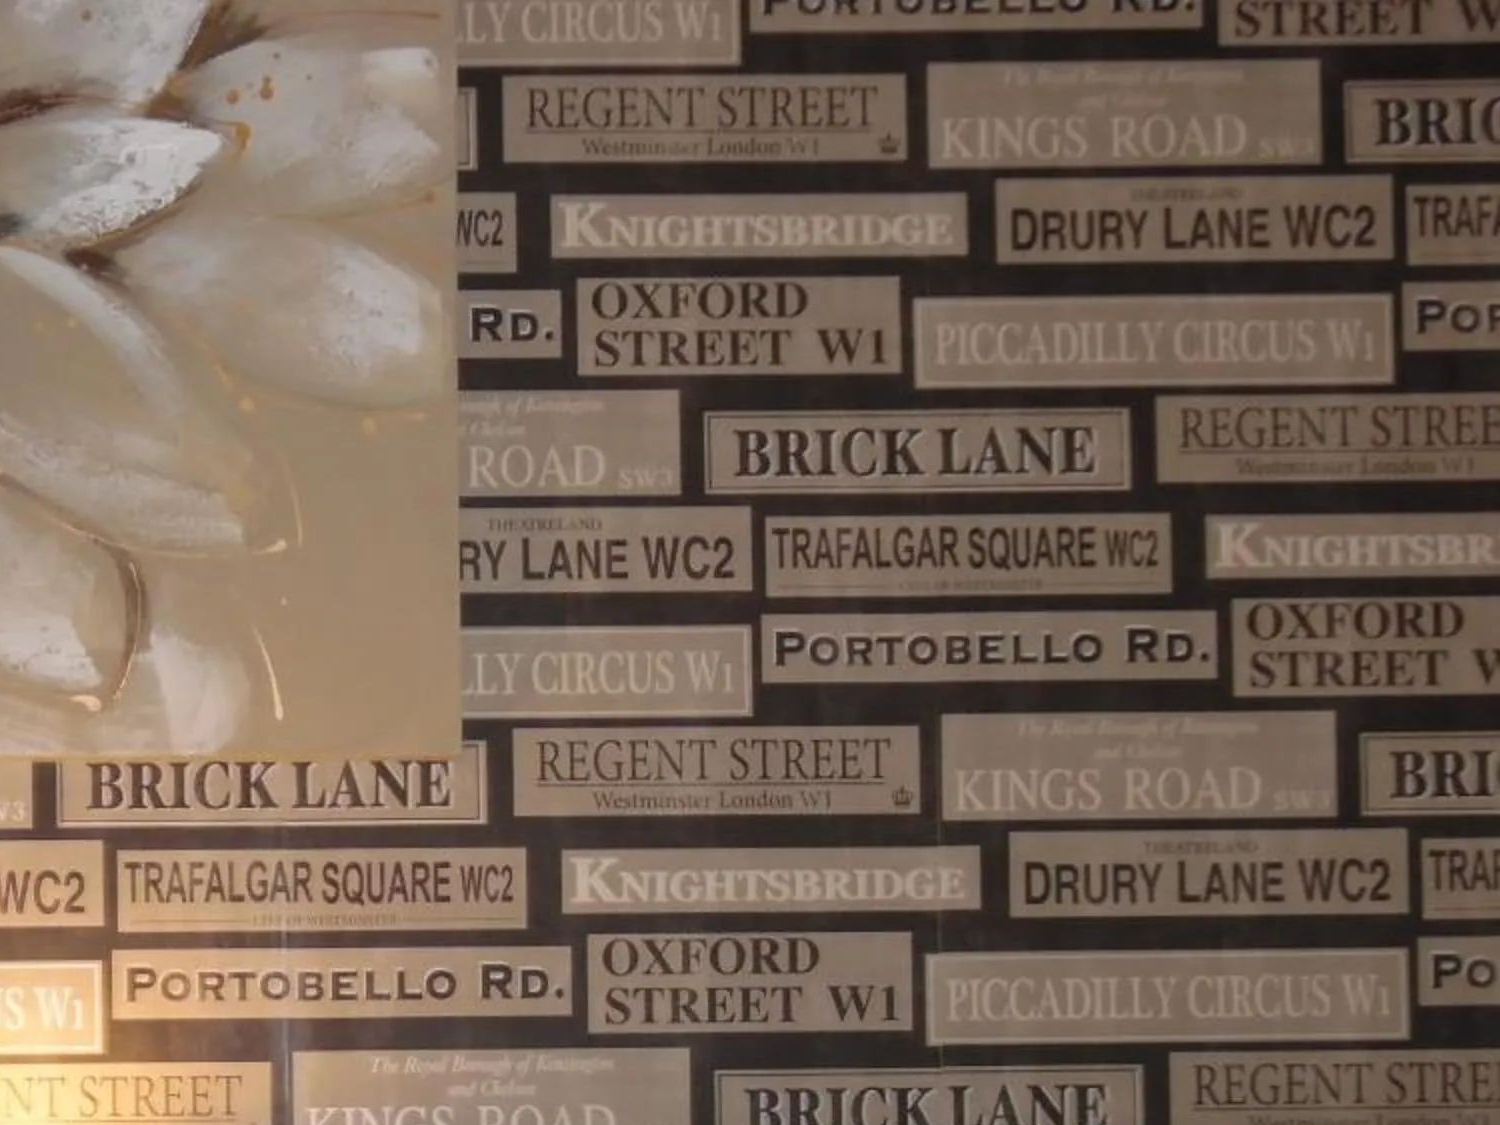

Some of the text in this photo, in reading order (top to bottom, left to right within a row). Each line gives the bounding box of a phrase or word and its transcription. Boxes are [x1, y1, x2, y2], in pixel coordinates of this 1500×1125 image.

[522, 2, 664, 44] CIRCUS
[1235, 0, 1431, 37] STREET
[526, 85, 878, 130] REGENT STREET
[707, 137, 781, 157] London
[942, 113, 1248, 160] KINGS ROAD
[557, 201, 954, 249] KNIGHTSBRIDGE
[1011, 208, 1148, 252] DRURY
[1164, 205, 1270, 249] LANE
[1283, 204, 1377, 248] WC2
[591, 281, 809, 319] OXFORD
[470, 305, 555, 342] RD.
[935, 320, 1169, 367] PICCADILLY
[1174, 319, 1316, 365] CIRCUS
[594, 328, 888, 368] STREET W1
[1180, 404, 1500, 448] REGENT STREE
[468, 445, 607, 489] ROAD
[734, 427, 1097, 478] BRICK LANE
[521, 537, 629, 580] LANE
[642, 535, 735, 580] WC2
[772, 525, 1159, 571] TRAFALGAR SQUARE WC2
[1246, 601, 1464, 640] OXFORD
[774, 625, 1210, 667] PORTOBELLO RD.
[532, 649, 675, 696] CIRCUS
[1250, 649, 1449, 689] STREET
[536, 738, 891, 783] REGENT STREET
[87, 760, 453, 811] BRICK LANE
[592, 790, 793, 811] Westminster London
[955, 767, 1262, 813] KINGS ROAD
[124, 860, 514, 906] TRAFALGAR SQUARE WC2
[569, 857, 965, 905] KNIGHTSBRIDGE
[1024, 861, 1164, 905] DRURY
[1177, 859, 1285, 904] LANE
[1298, 858, 1392, 902] WC2
[602, 937, 820, 977] OXFORD
[127, 962, 565, 1003] PORTOBELLO RD.
[604, 984, 900, 1026] STREET W1
[947, 976, 1179, 1022] PICCADILLY
[1186, 974, 1331, 1020] CIRCUS
[35, 986, 84, 1031] W1
[79, 1074, 243, 1119] STREET
[1194, 1061, 1500, 1107] REGENT STRE
